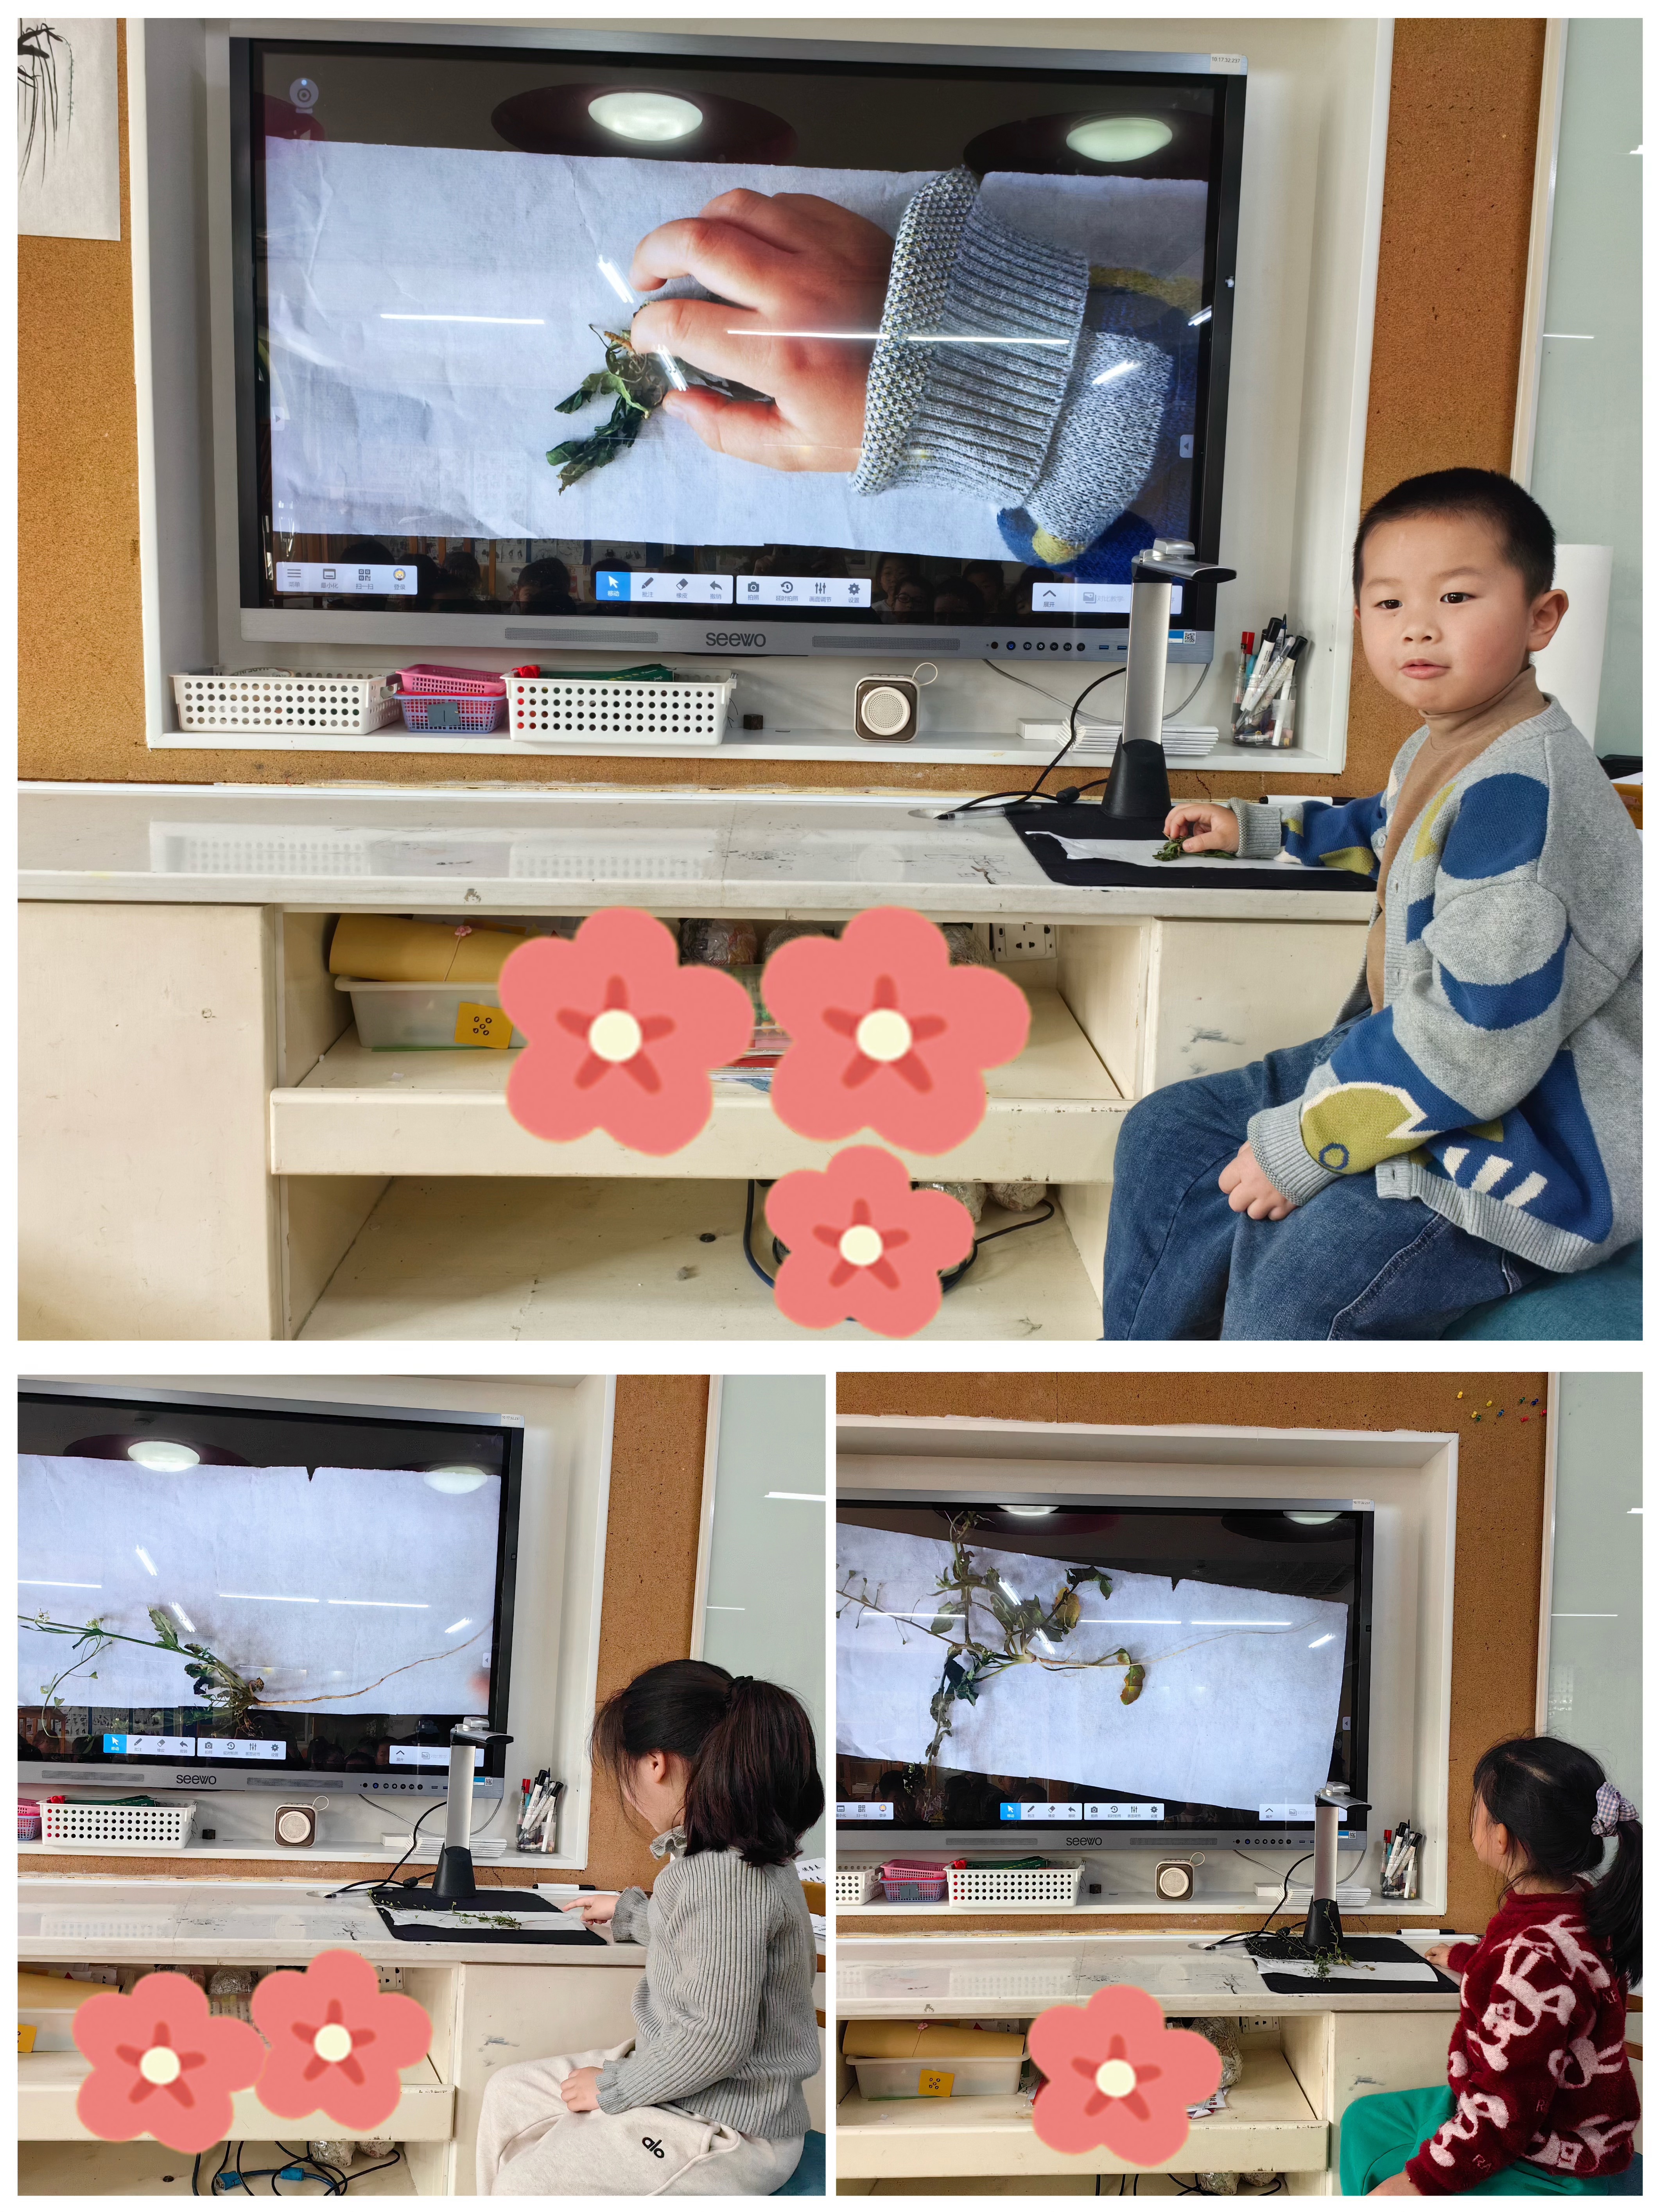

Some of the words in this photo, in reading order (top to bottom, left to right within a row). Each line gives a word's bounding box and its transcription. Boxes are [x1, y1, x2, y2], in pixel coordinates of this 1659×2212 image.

[706, 633, 766, 647] seewo
[176, 1775, 217, 1785] seewo
[1066, 1837, 1102, 1846] seewo
